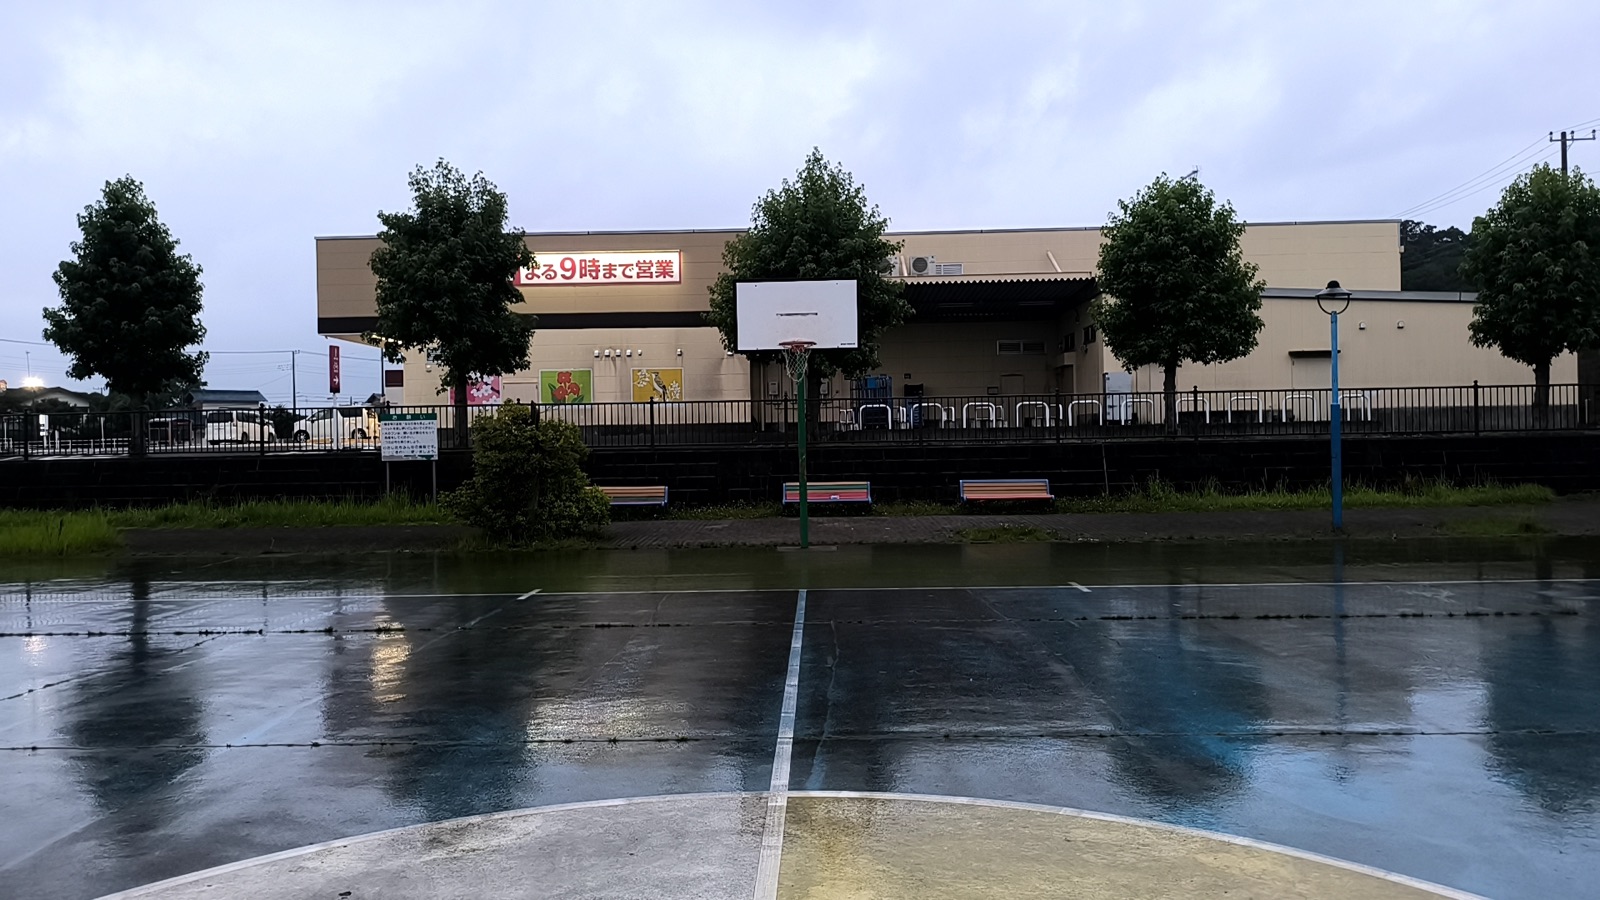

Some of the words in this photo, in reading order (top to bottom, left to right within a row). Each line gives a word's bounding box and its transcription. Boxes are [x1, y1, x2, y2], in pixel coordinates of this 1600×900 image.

[525, 257, 674, 280] よる9時まで営業
